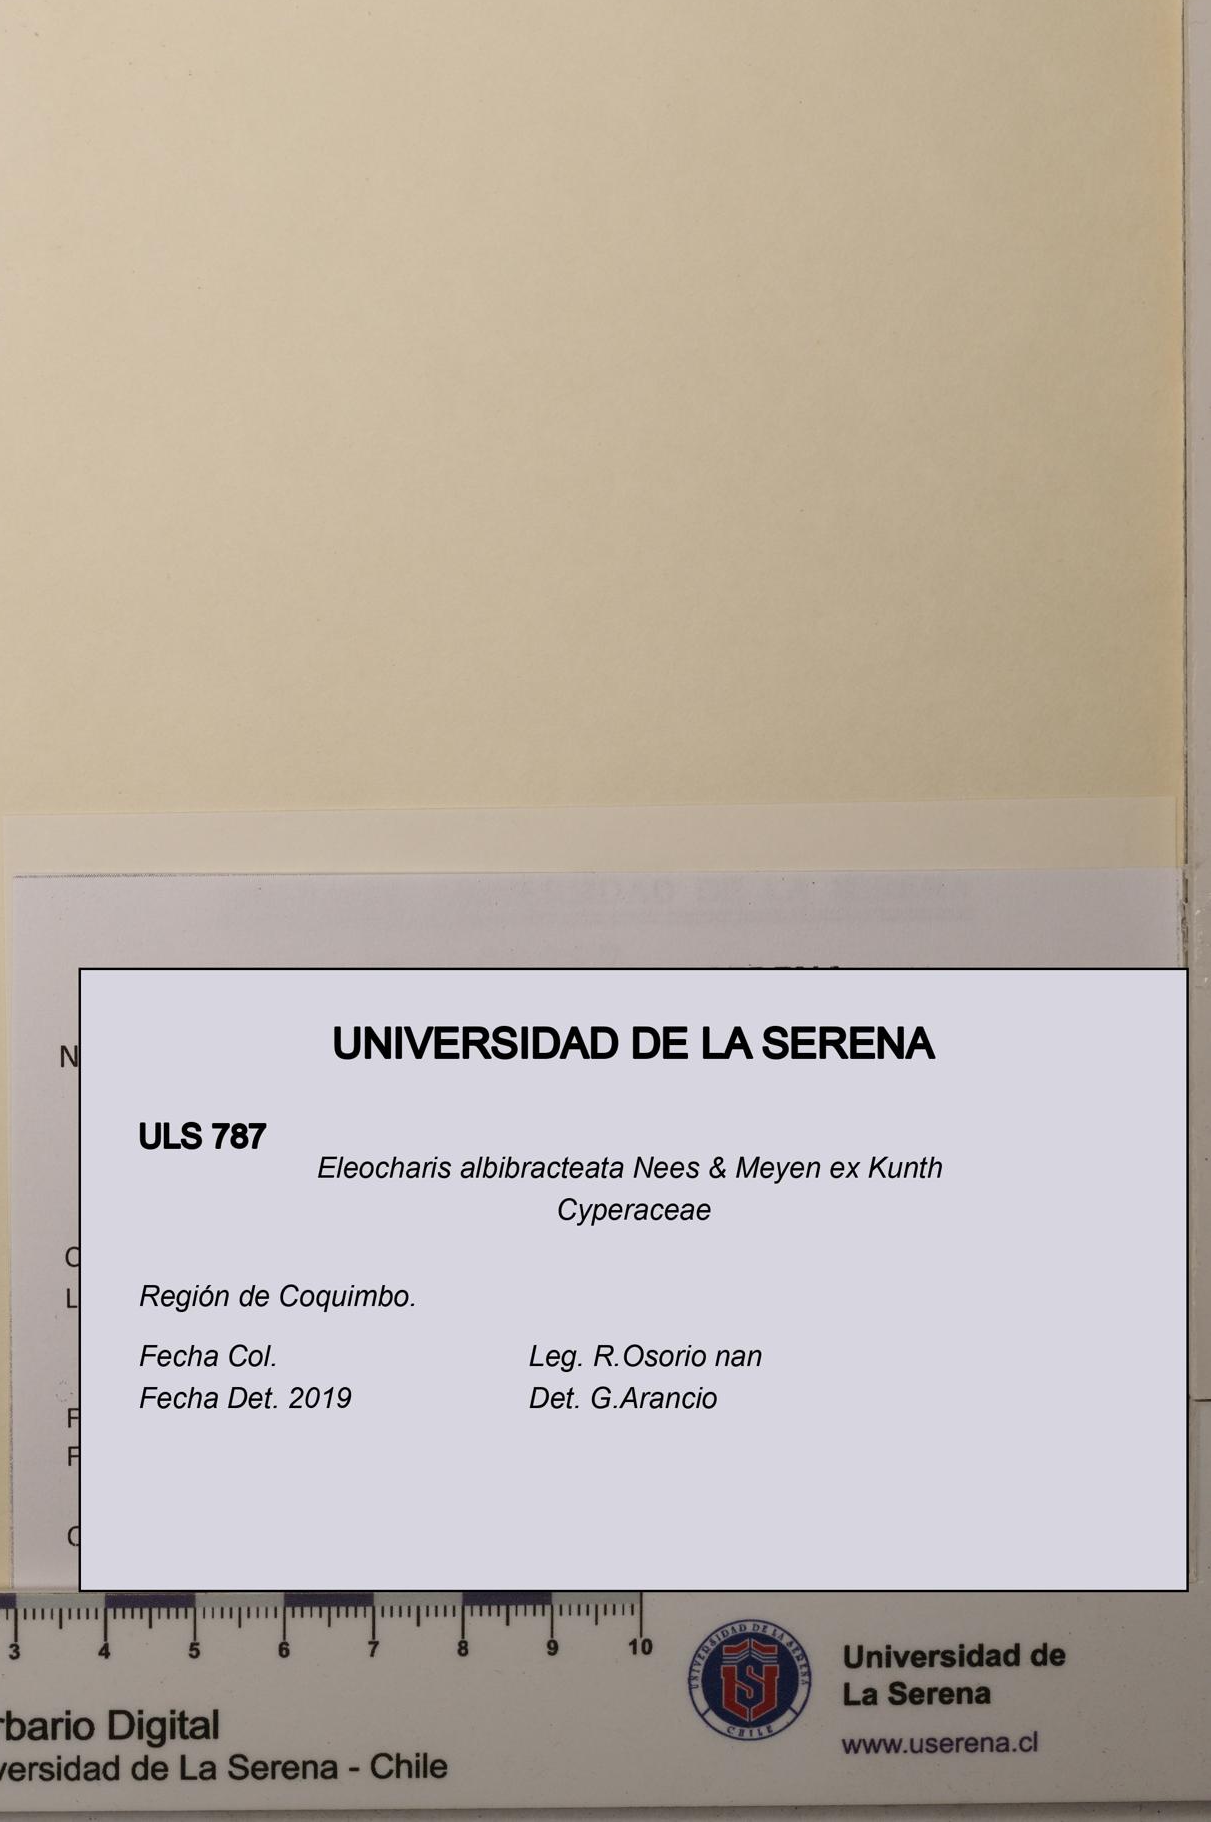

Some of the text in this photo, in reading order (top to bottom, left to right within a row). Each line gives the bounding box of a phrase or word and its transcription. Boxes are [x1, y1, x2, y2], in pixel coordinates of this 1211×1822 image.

[8, 1641, 21, 1661] 3
[97, 1641, 111, 1660] 4
[188, 1640, 201, 1660] 5
[277, 1640, 291, 1659] 6
[367, 1639, 380, 1658] 7
[456, 1639, 470, 1658] 8
[545, 1638, 560, 1657] 9
[628, 1637, 654, 1656] 10
[843, 1641, 1067, 1670] Universidad de
[843, 1680, 992, 1707] La Serena
[108, 1708, 220, 1749] Digital
[841, 1730, 1039, 1755] www.userena.cl
[130, 1754, 170, 1782] de
[179, 1753, 217, 1782] La
[227, 1753, 339, 1781] Serena
[370, 1751, 448, 1780] Chile
